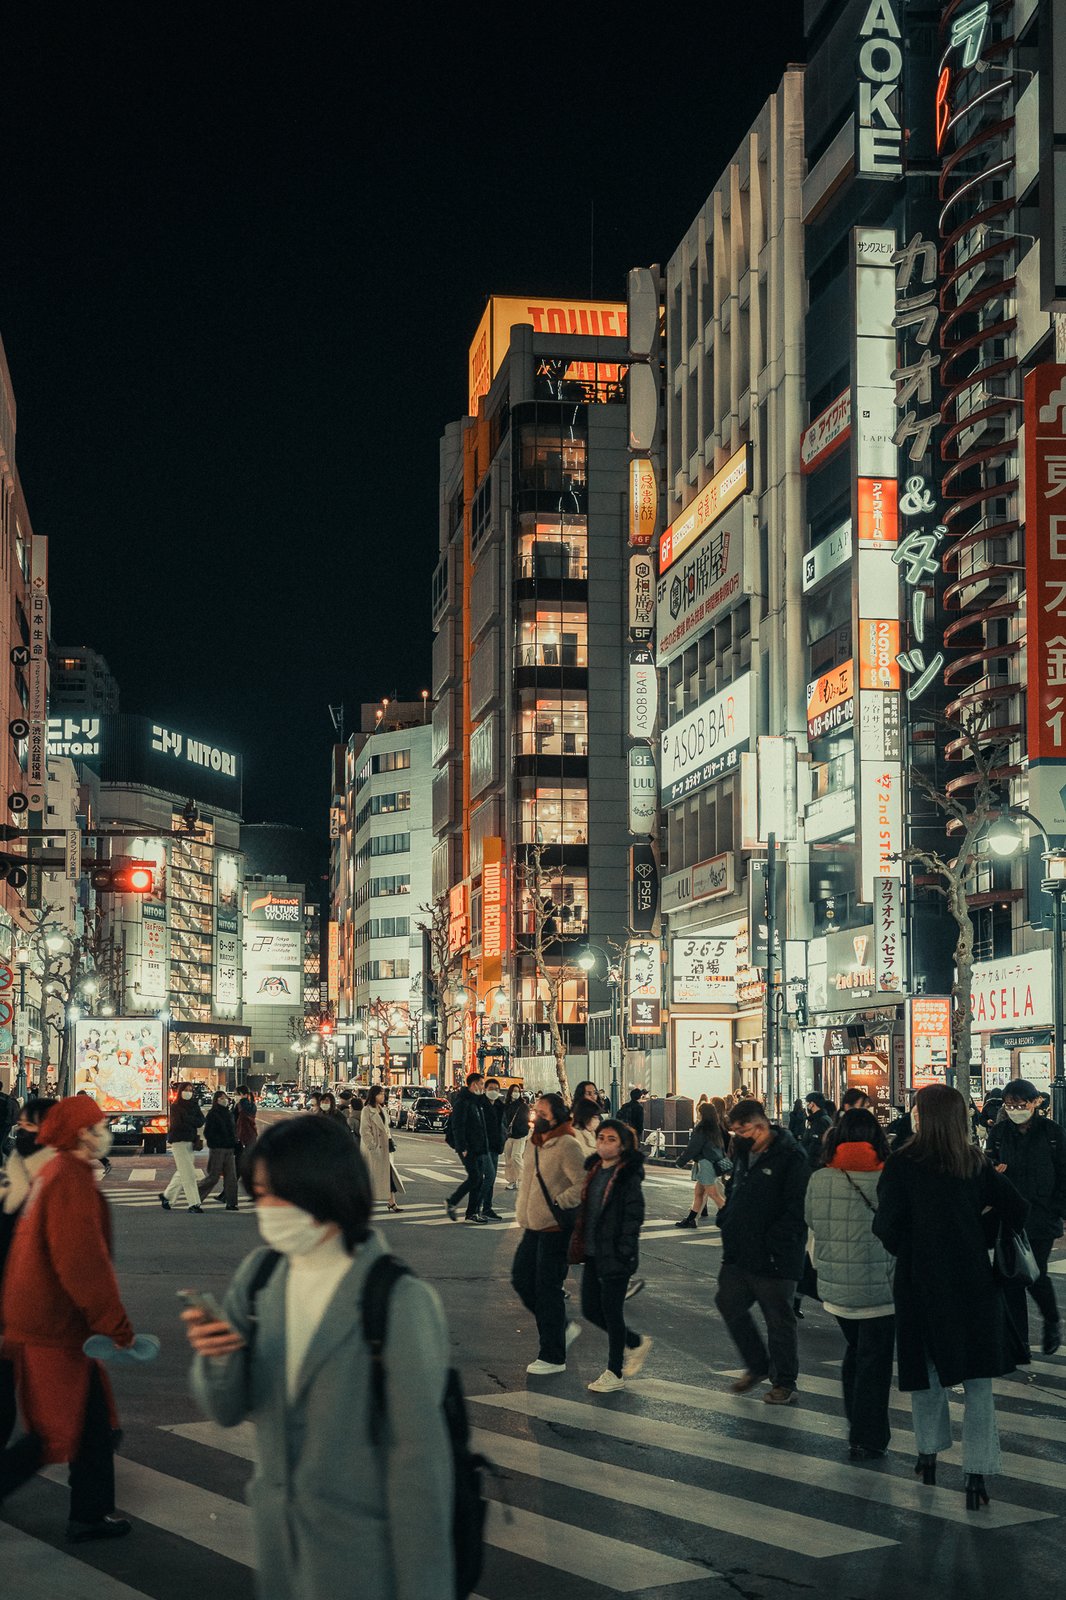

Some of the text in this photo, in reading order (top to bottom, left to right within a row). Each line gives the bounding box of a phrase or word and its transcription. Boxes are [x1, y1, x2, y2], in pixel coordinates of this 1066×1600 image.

[32, 599, 43, 655] 日本生命
[635, 628, 650, 638] 5F
[635, 653, 649, 662] 4F
[47, 718, 100, 740] ニトリ
[47, 742, 100, 755] NITORI
[152, 724, 236, 777] ニトリ NITORI
[635, 755, 650, 765] 3F
[879, 794, 890, 825] 2nd
[641, 880, 652, 911] PSFA
[143, 904, 165, 918] NITORI
[264, 905, 299, 914] CULTURE
[484, 861, 500, 957] TOWER RECORDS
[265, 912, 299, 921] WORKS
[218, 919, 236, 930] NITORI
[881, 879, 896, 970] カラオケ パセラ
